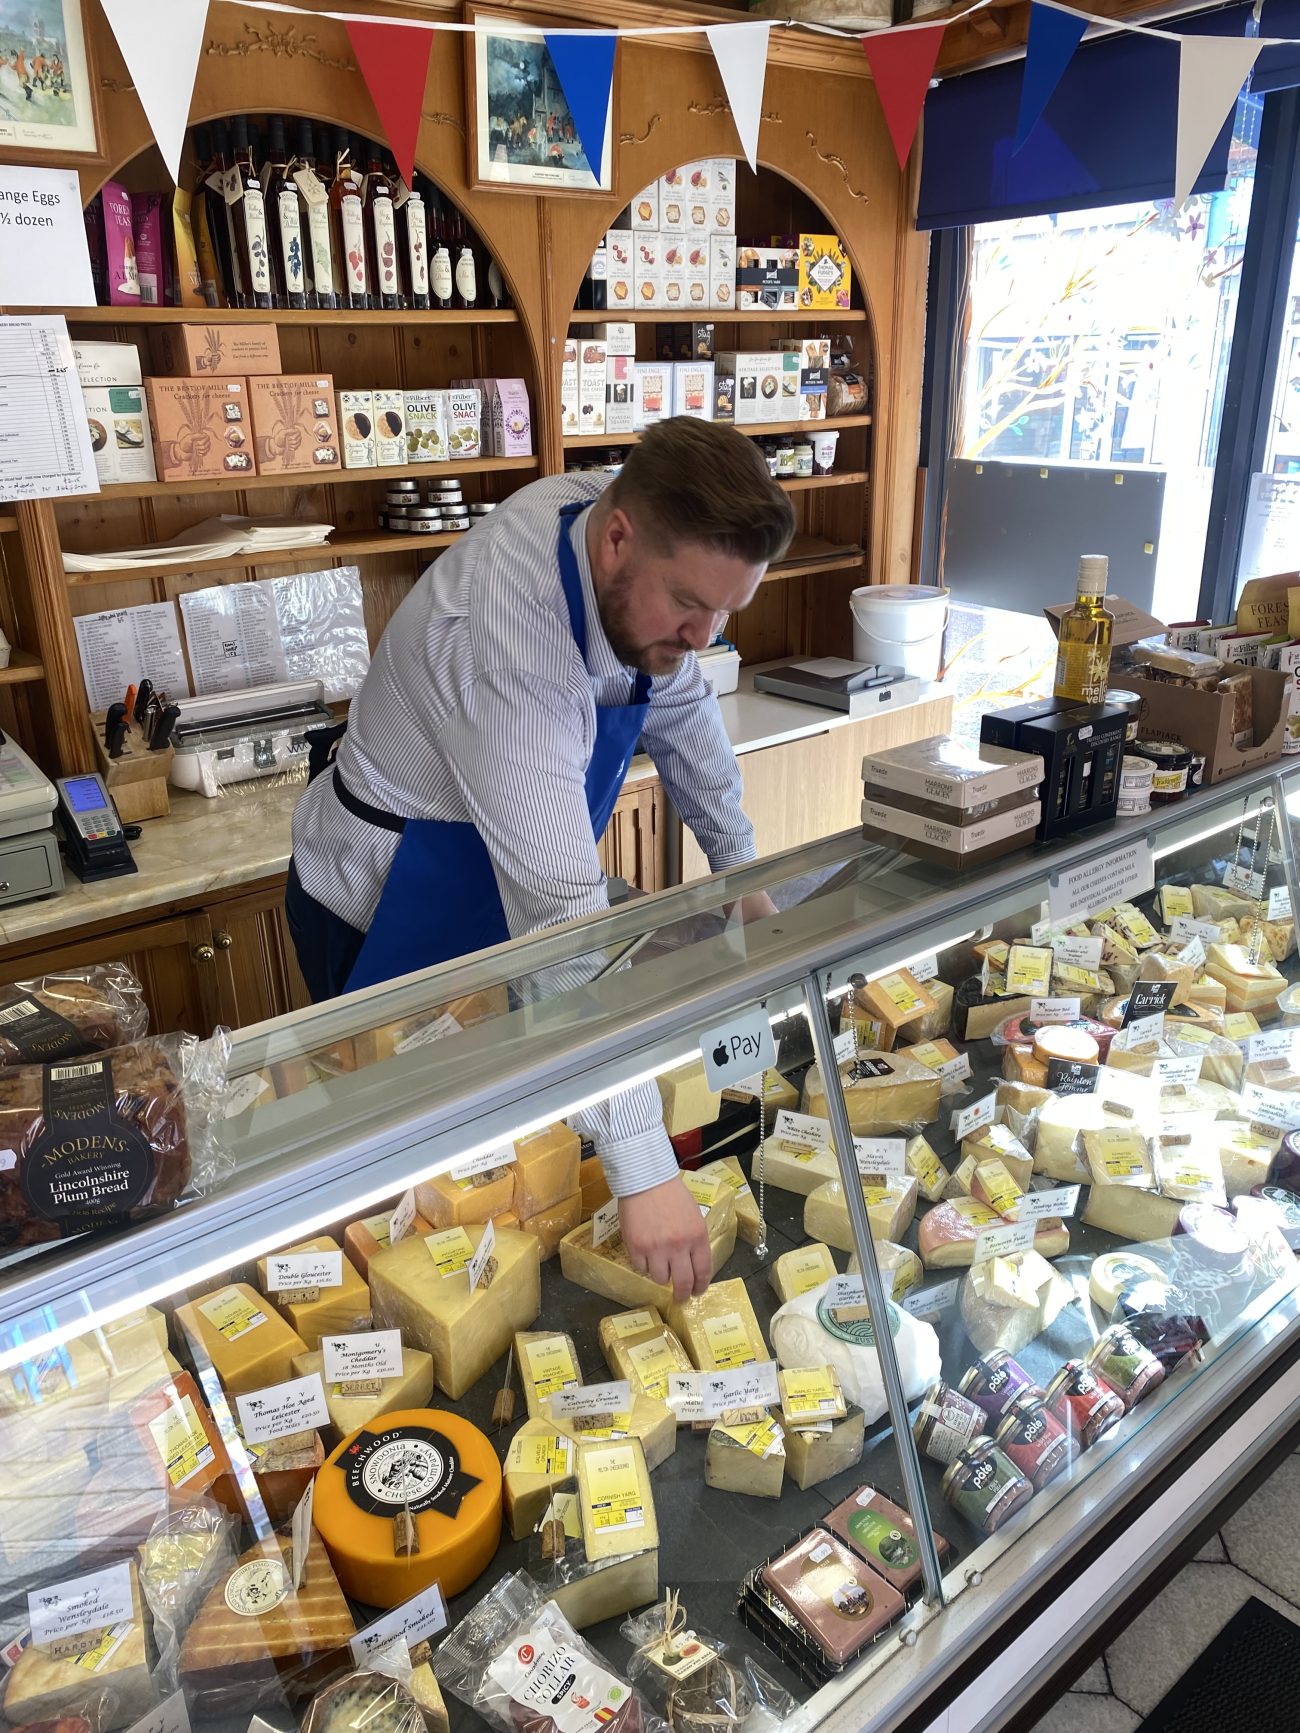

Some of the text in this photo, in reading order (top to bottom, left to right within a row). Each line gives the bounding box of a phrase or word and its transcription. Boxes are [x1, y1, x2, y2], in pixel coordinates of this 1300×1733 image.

[32, 190, 60, 204] Eggs
[15, 214, 53, 227] dozen
[697, 327, 711, 345] stag
[407, 404, 437, 413] OLIVE
[408, 412, 437, 420] SNACK
[1141, 726, 1183, 742] FLAPJACK
[1016, 765, 1039, 776] MARRONS
[925, 778, 953, 792] MARRONS
[1014, 809, 1035, 821] MARRONS
[924, 823, 952, 837] MARRONS
[1068, 850, 1137, 885] FOOD ALLERGY INFORMATION
[1072, 863, 1135, 896] ALL OUR CHEESES CONTAIN MILK
[1070, 873, 1138, 910] SEE INDIVIDUAL LABELS FOR OTHER
[1087, 889, 1123, 910] ALLERGEN ADVICE
[1135, 992, 1167, 1005] Carrick
[730, 1031, 762, 1060] Pay
[1056, 1071, 1093, 1087] Rainton
[801, 1129, 822, 1138] Cheshire
[45, 1135, 127, 1166] MODENS
[67, 1151, 105, 1165] BAKERY
[472, 1152, 495, 1163] Cheddar
[54, 1161, 122, 1180] Gold Award Winning
[49, 1169, 130, 1194] Lincolnshire
[53, 1180, 130, 1205] Plum Bread
[300, 1270, 332, 1279] Gloucester
[341, 1348, 386, 1359] Montgomery's
[350, 1355, 378, 1364] Cheddar
[349, 1362, 375, 1370] Months
[349, 1369, 360, 1377] per
[361, 1368, 371, 1376] Kg
[542, 1365, 561, 1375] VINTAGE
[988, 1369, 1009, 1394] pâté
[723, 1386, 760, 1399] Garlic Yarg
[254, 1394, 316, 1419] Thomas Hoe Aged
[567, 1399, 595, 1407] Calveley
[712, 1398, 739, 1409] Price per
[271, 1408, 302, 1422] Leicester
[255, 1423, 270, 1433] Price
[270, 1421, 283, 1430] per
[284, 1417, 293, 1425] Kg
[268, 1421, 301, 1436] Food Miles
[1024, 1417, 1043, 1443] pâté
[351, 1431, 400, 1487] BEECHWOOD
[369, 1443, 406, 1485] SNOWDONIA
[973, 1461, 993, 1490] pâté
[408, 1499, 432, 1512] Naturally
[430, 1486, 446, 1503] Smoked
[597, 1490, 636, 1502] CORNISH YARG
[66, 1597, 99, 1612] Smoked
[57, 1603, 110, 1623] Wensleydale
[407, 1607, 435, 1631] Smoked
[44, 1625, 64, 1636] Price
[63, 1622, 79, 1633] per
[523, 1645, 567, 1702] CHORIZO
[535, 1655, 576, 1706] COLLAR
[557, 1680, 573, 1700] SPICY
